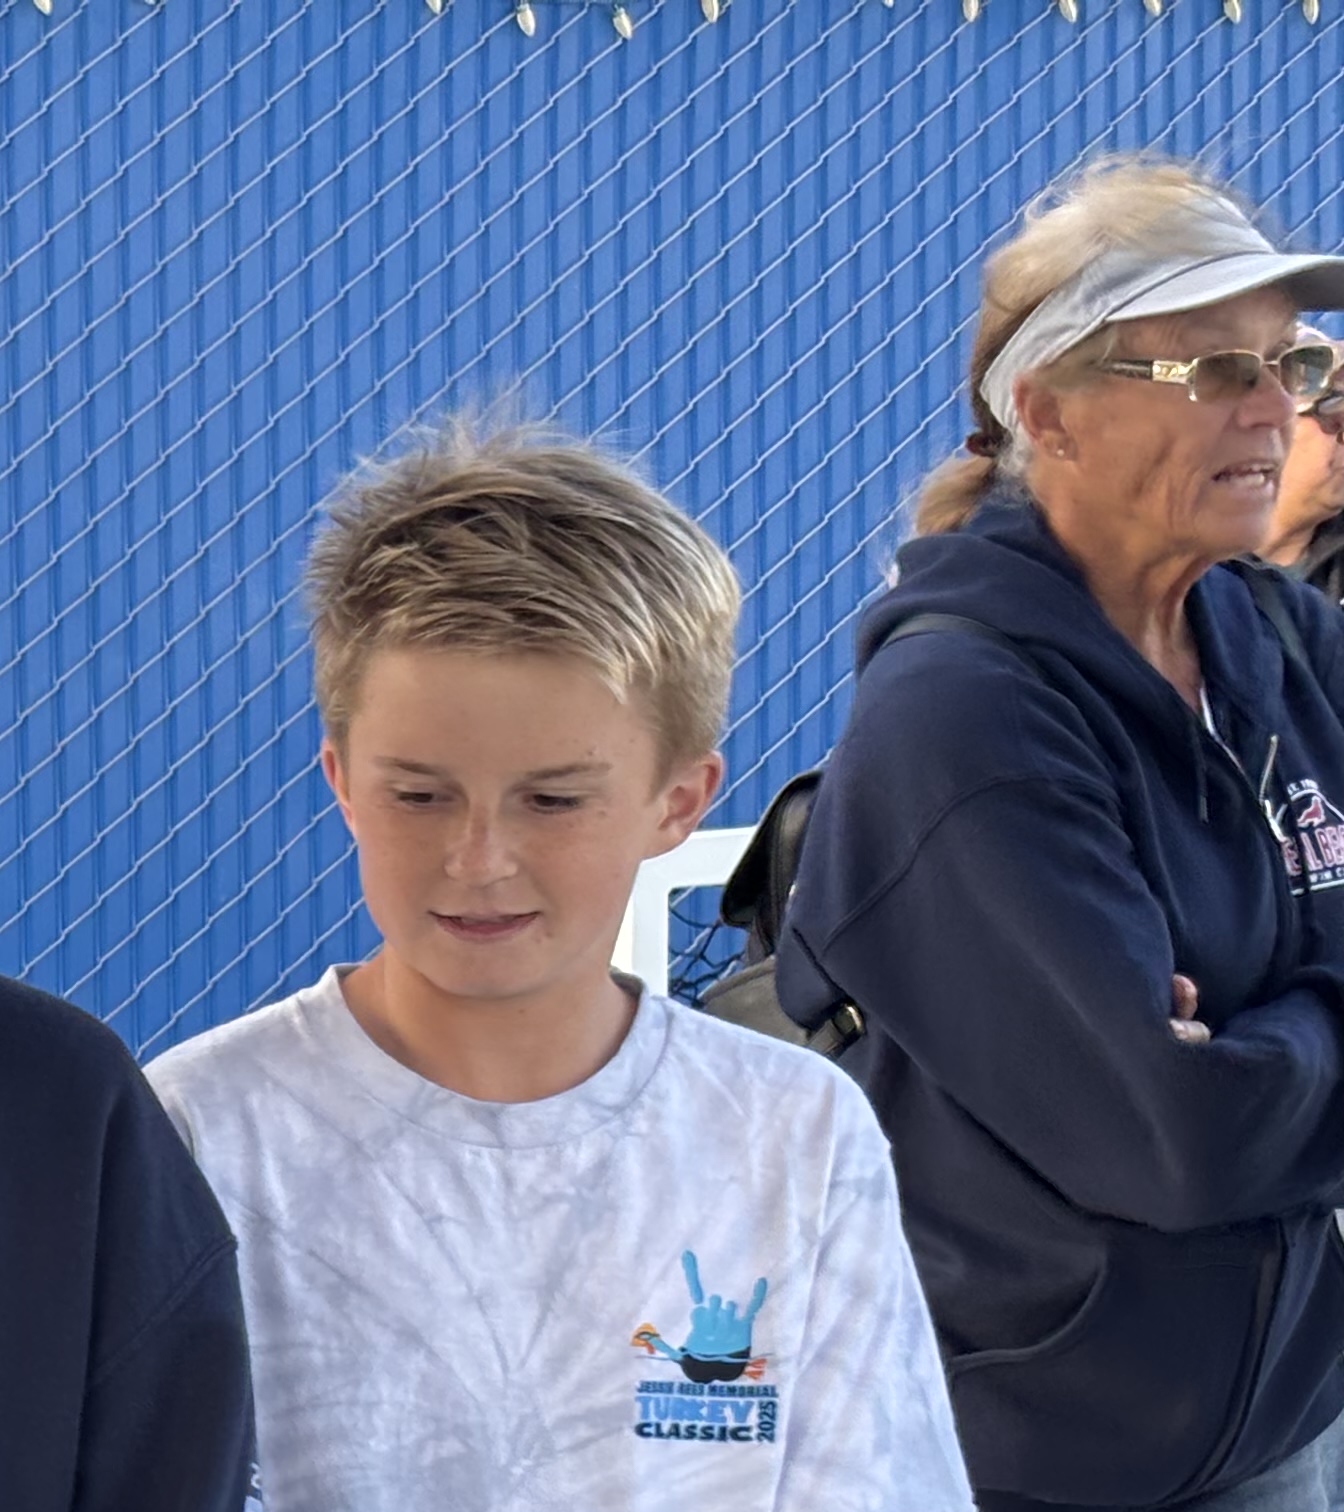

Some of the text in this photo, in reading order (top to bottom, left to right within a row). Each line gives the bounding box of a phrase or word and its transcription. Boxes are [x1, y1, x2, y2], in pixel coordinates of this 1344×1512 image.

[708, 1384, 779, 1398] MEMORIAL
[635, 1396, 755, 1423] TURKEY
[757, 1399, 779, 1443] 2025
[635, 1422, 753, 1442] CLASSIC
